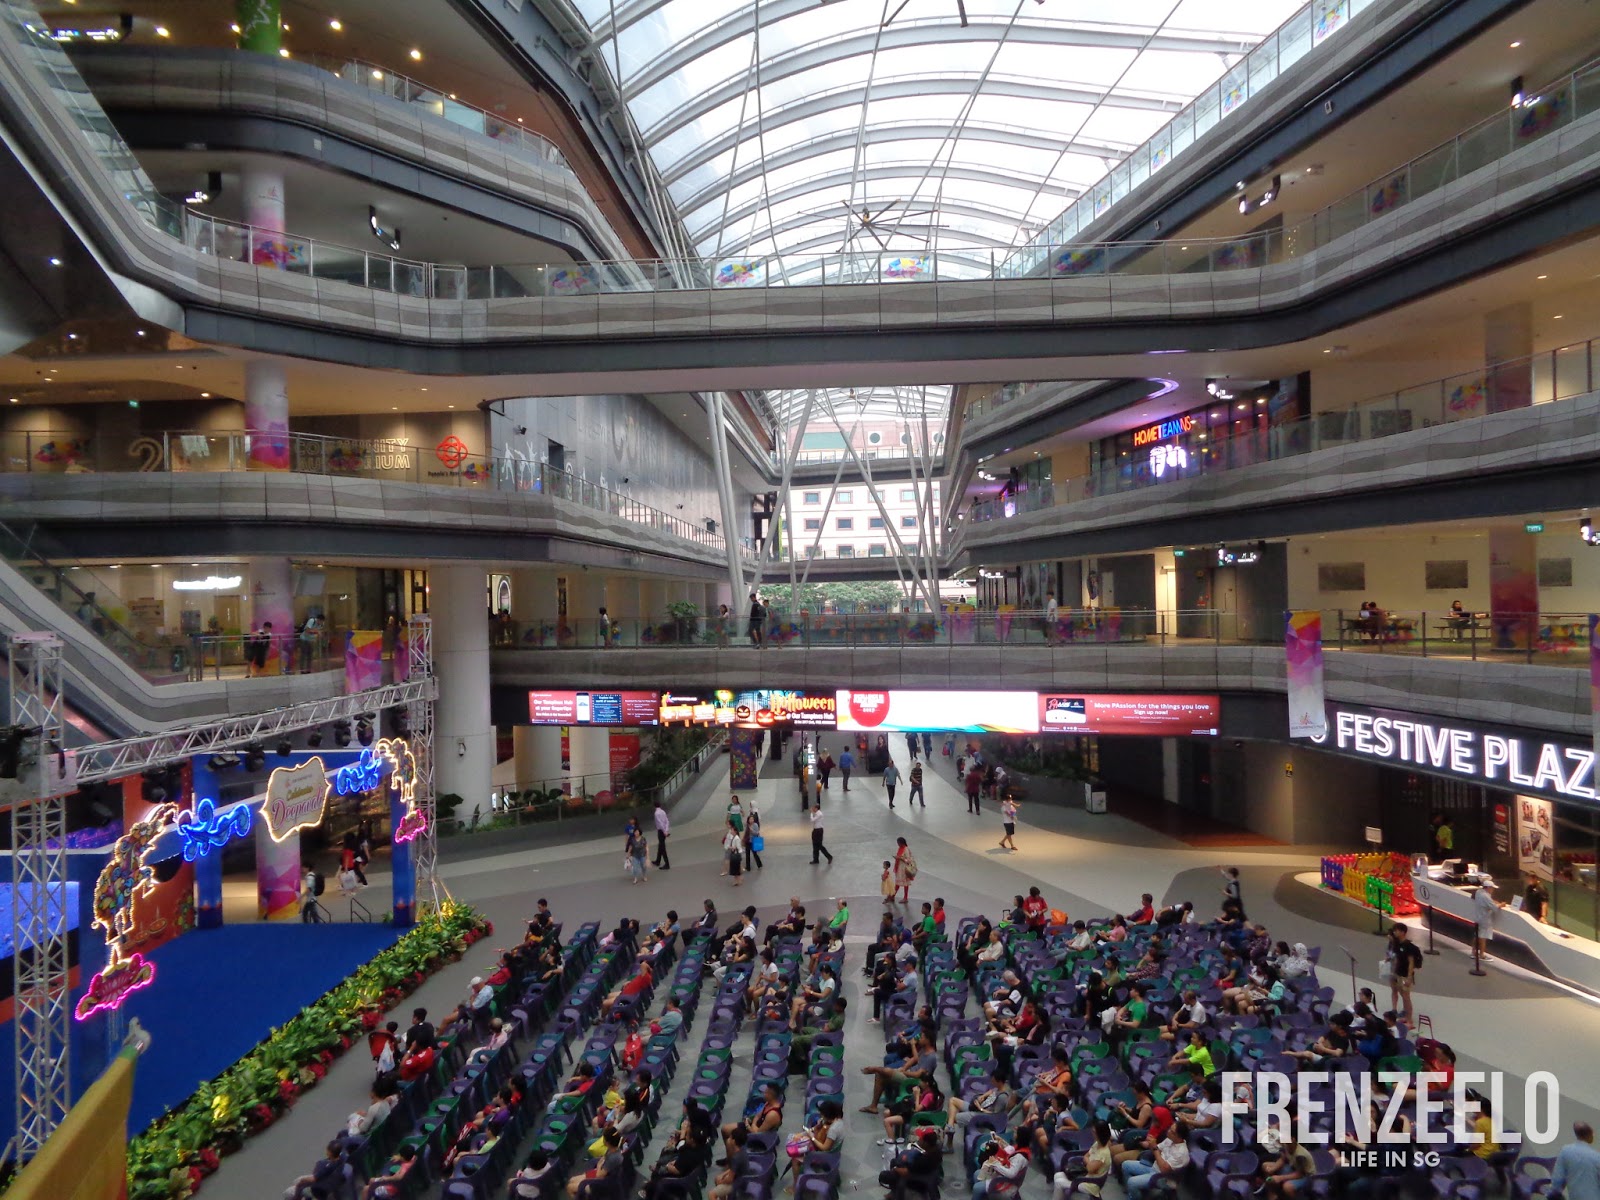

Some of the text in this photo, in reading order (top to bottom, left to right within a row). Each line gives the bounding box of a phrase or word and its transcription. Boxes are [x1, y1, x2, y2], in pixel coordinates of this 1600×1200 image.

[1134, 415, 1192, 447] HOMETEAMNS
[299, 438, 409, 456] COUNITY
[299, 454, 411, 472] AURIUM
[1161, 703, 1181, 711] things
[1336, 711, 1600, 801] FESTIVE PLAZ
[271, 785, 324, 831] Deepavali
